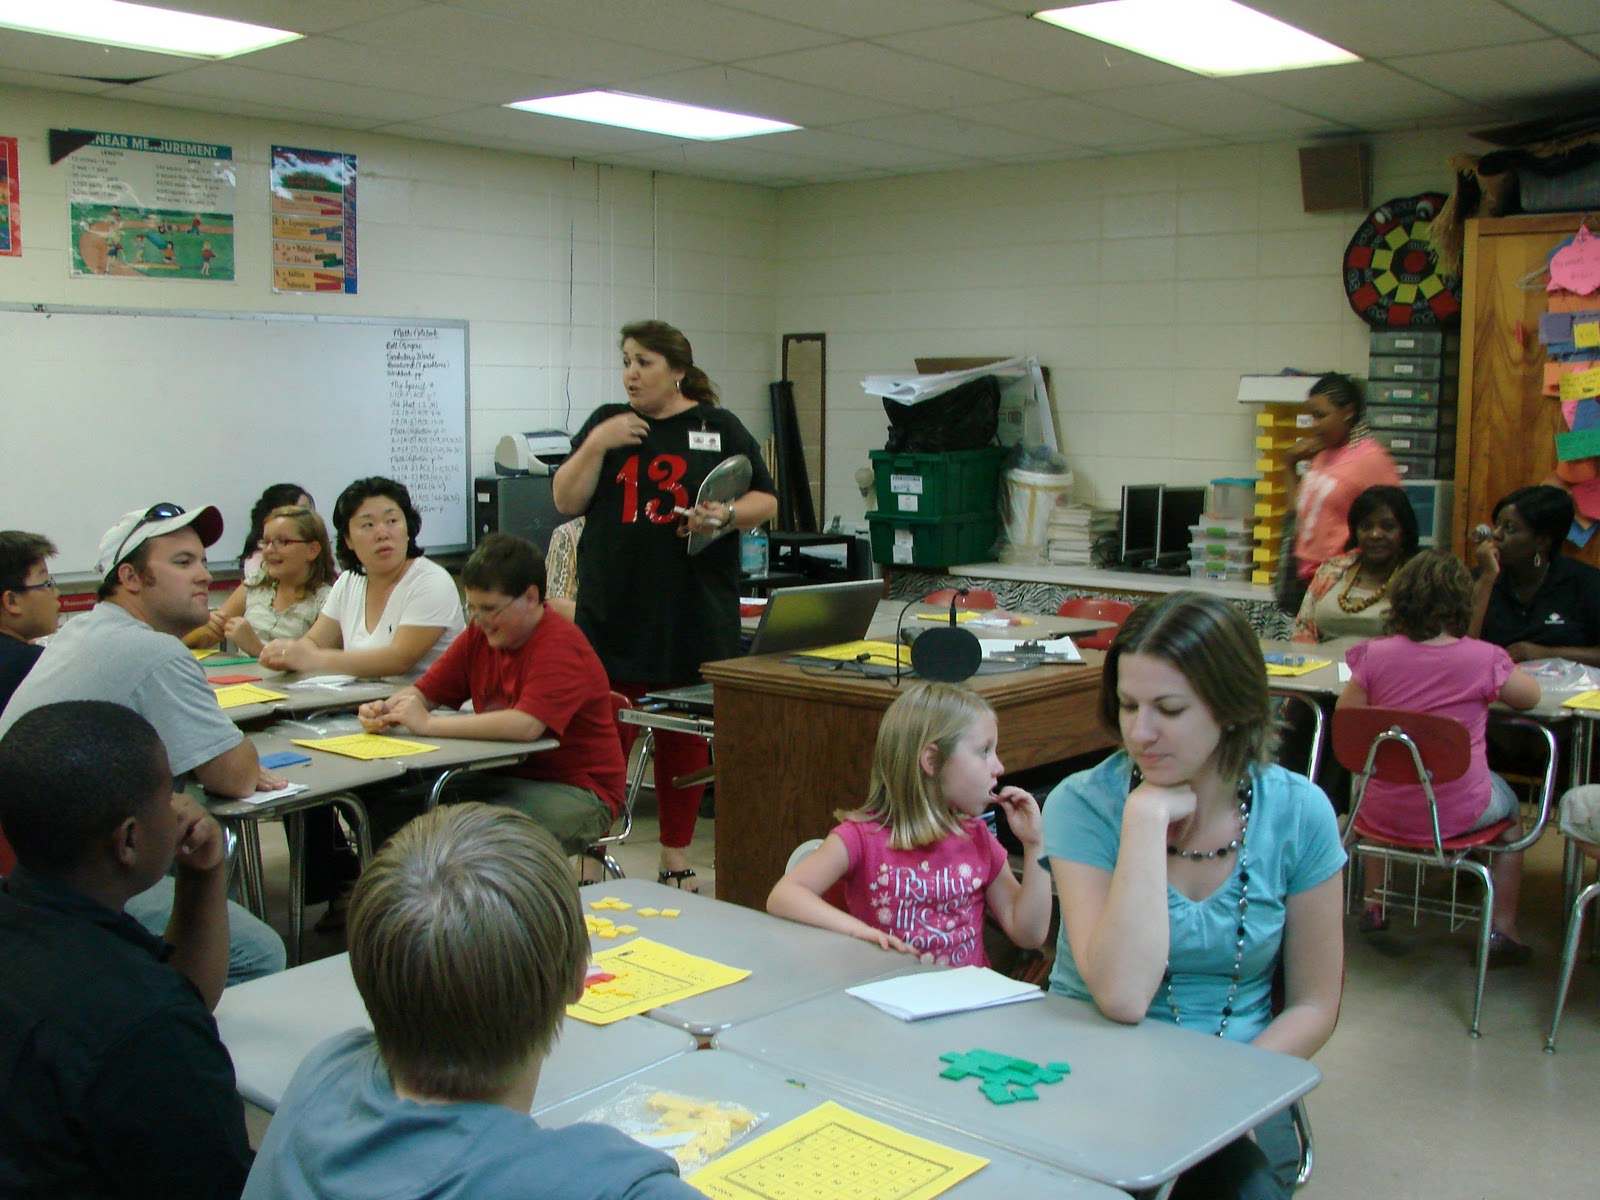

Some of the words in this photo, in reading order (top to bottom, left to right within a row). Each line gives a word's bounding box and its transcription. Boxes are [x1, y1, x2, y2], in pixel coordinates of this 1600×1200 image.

[92, 133, 128, 149] NEAR
[132, 138, 218, 157] MESUREMENT
[615, 453, 690, 524] 13
